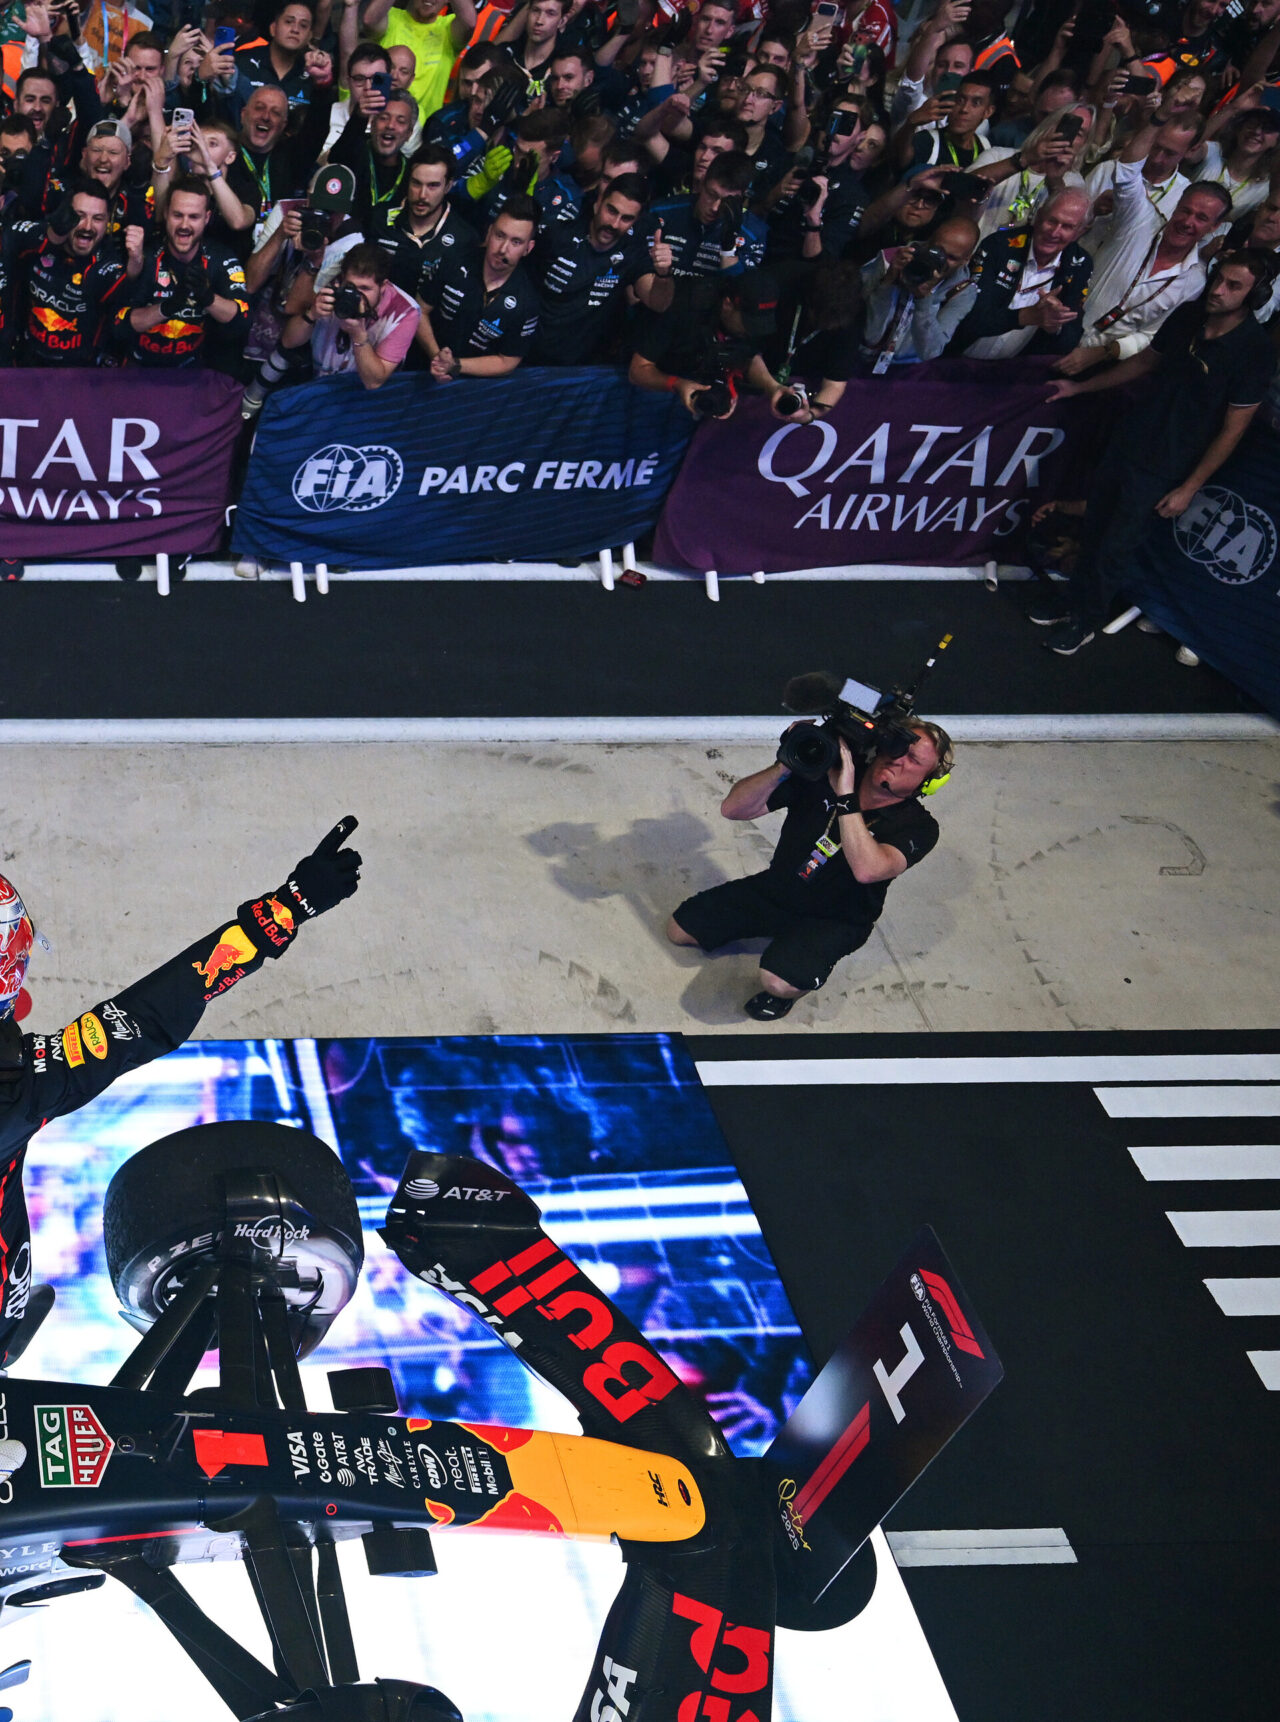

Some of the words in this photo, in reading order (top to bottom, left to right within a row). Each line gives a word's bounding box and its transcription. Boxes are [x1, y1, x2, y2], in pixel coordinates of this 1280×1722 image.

[29, 281, 87, 313] ORACLE
[47, 333, 82, 351] Bull
[419, 462, 526, 496] PARC
[533, 453, 660, 491] FERMÉ
[757, 419, 1066, 497] QATAR
[794, 493, 1031, 538] AIRWAYS
[251, 901, 269, 927] Red
[261, 922, 289, 947] Bull
[222, 968, 246, 988] Bull
[84, 1016, 101, 1046] RAUCH
[33, 1036, 47, 1073] Mob
[442, 1186, 511, 1202] AT&T
[233, 1223, 271, 1239] Hard
[469, 1237, 679, 1423] Bull
[922, 1302, 936, 1327] World
[932, 1326, 961, 1383] Championship
[931, 1312, 948, 1345] Formula
[43, 1412, 65, 1481] TAG
[74, 1410, 103, 1482] HEUER
[287, 1431, 311, 1479] VISA
[331, 1432, 349, 1467] AT&T
[354, 1447, 368, 1474] AVA
[361, 1437, 379, 1485] TRADE
[403, 1440, 421, 1489] CARLYLE
[384, 1462, 405, 1488] Maui
[424, 1454, 442, 1489] CDW
[445, 1446, 466, 1491] neat.
[461, 1446, 483, 1493] PIRELLI
[483, 1459, 499, 1495] Mobil
[648, 1470, 668, 1507] HRC
[778, 1479, 812, 1551] Qatar
[780, 1510, 799, 1550] 2025
